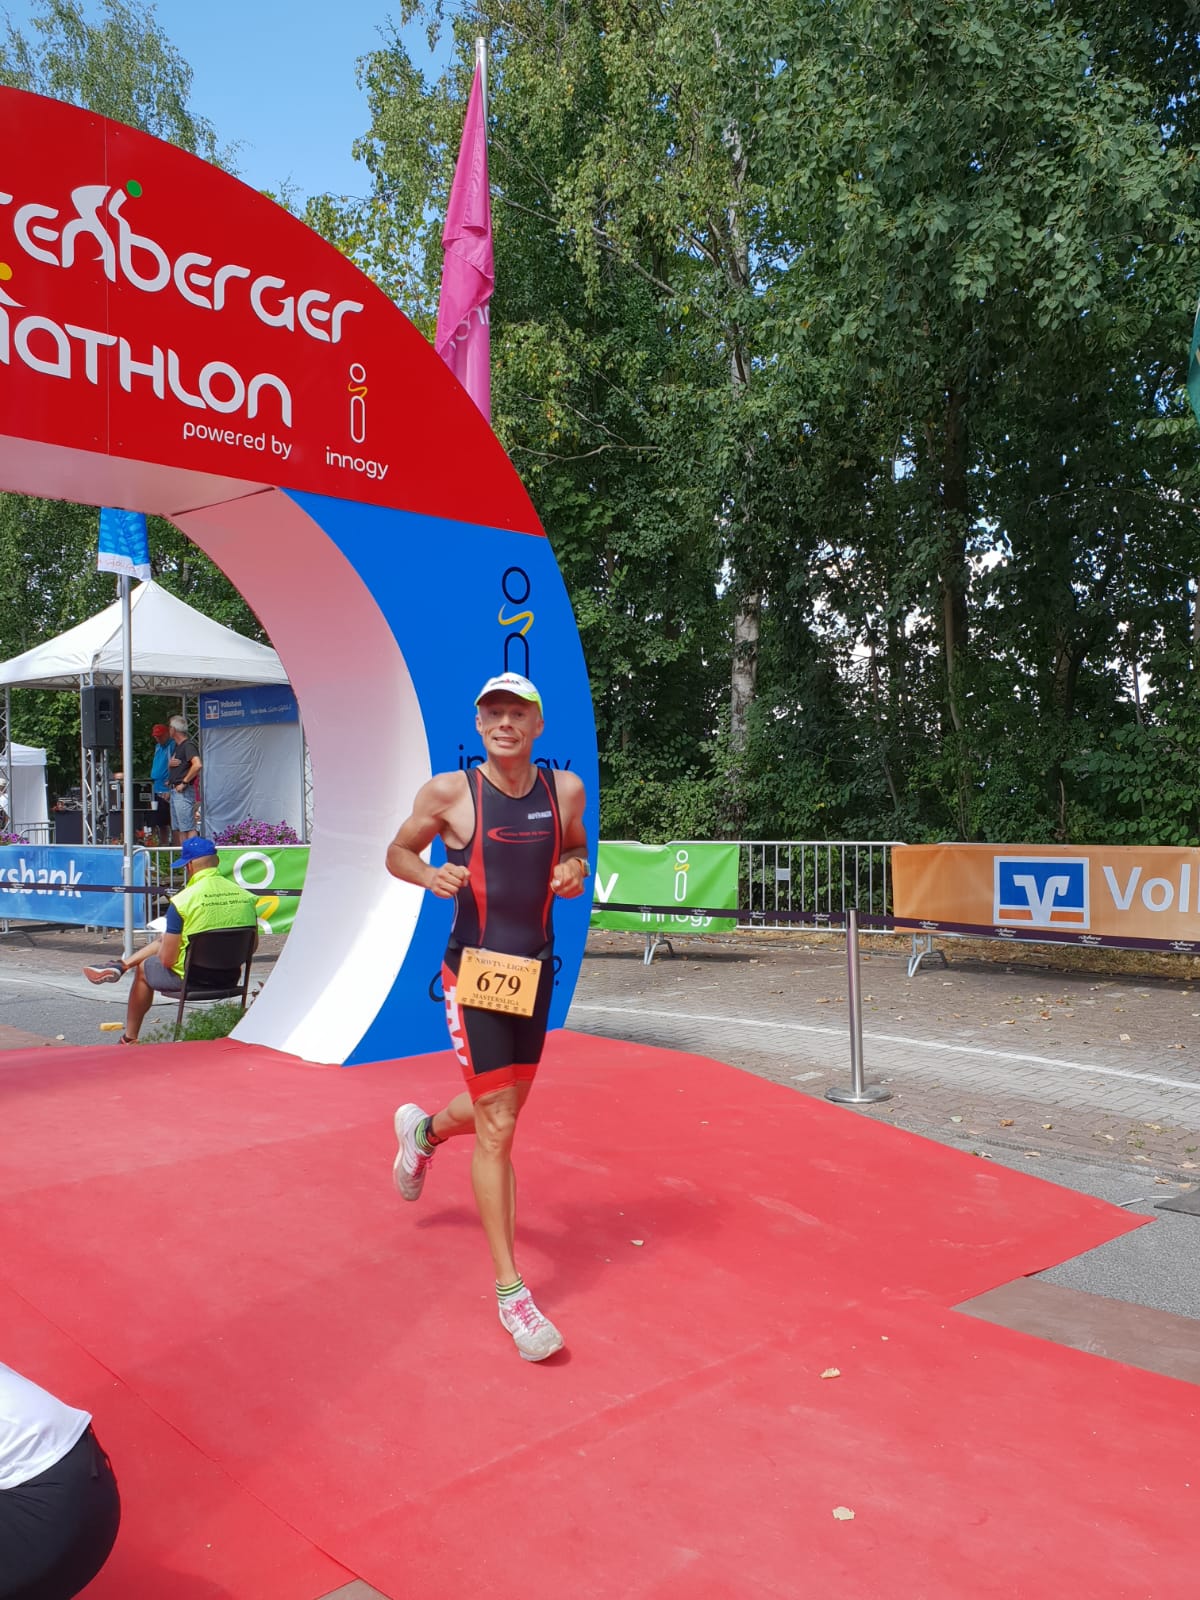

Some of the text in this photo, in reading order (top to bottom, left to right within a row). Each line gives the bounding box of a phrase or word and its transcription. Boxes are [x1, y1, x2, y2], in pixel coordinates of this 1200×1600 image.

[0, 185, 364, 343] enberger
[183, 421, 292, 460] powered by
[326, 446, 388, 480] innogy
[1102, 863, 1200, 913] Vol
[477, 970, 522, 996] 679
